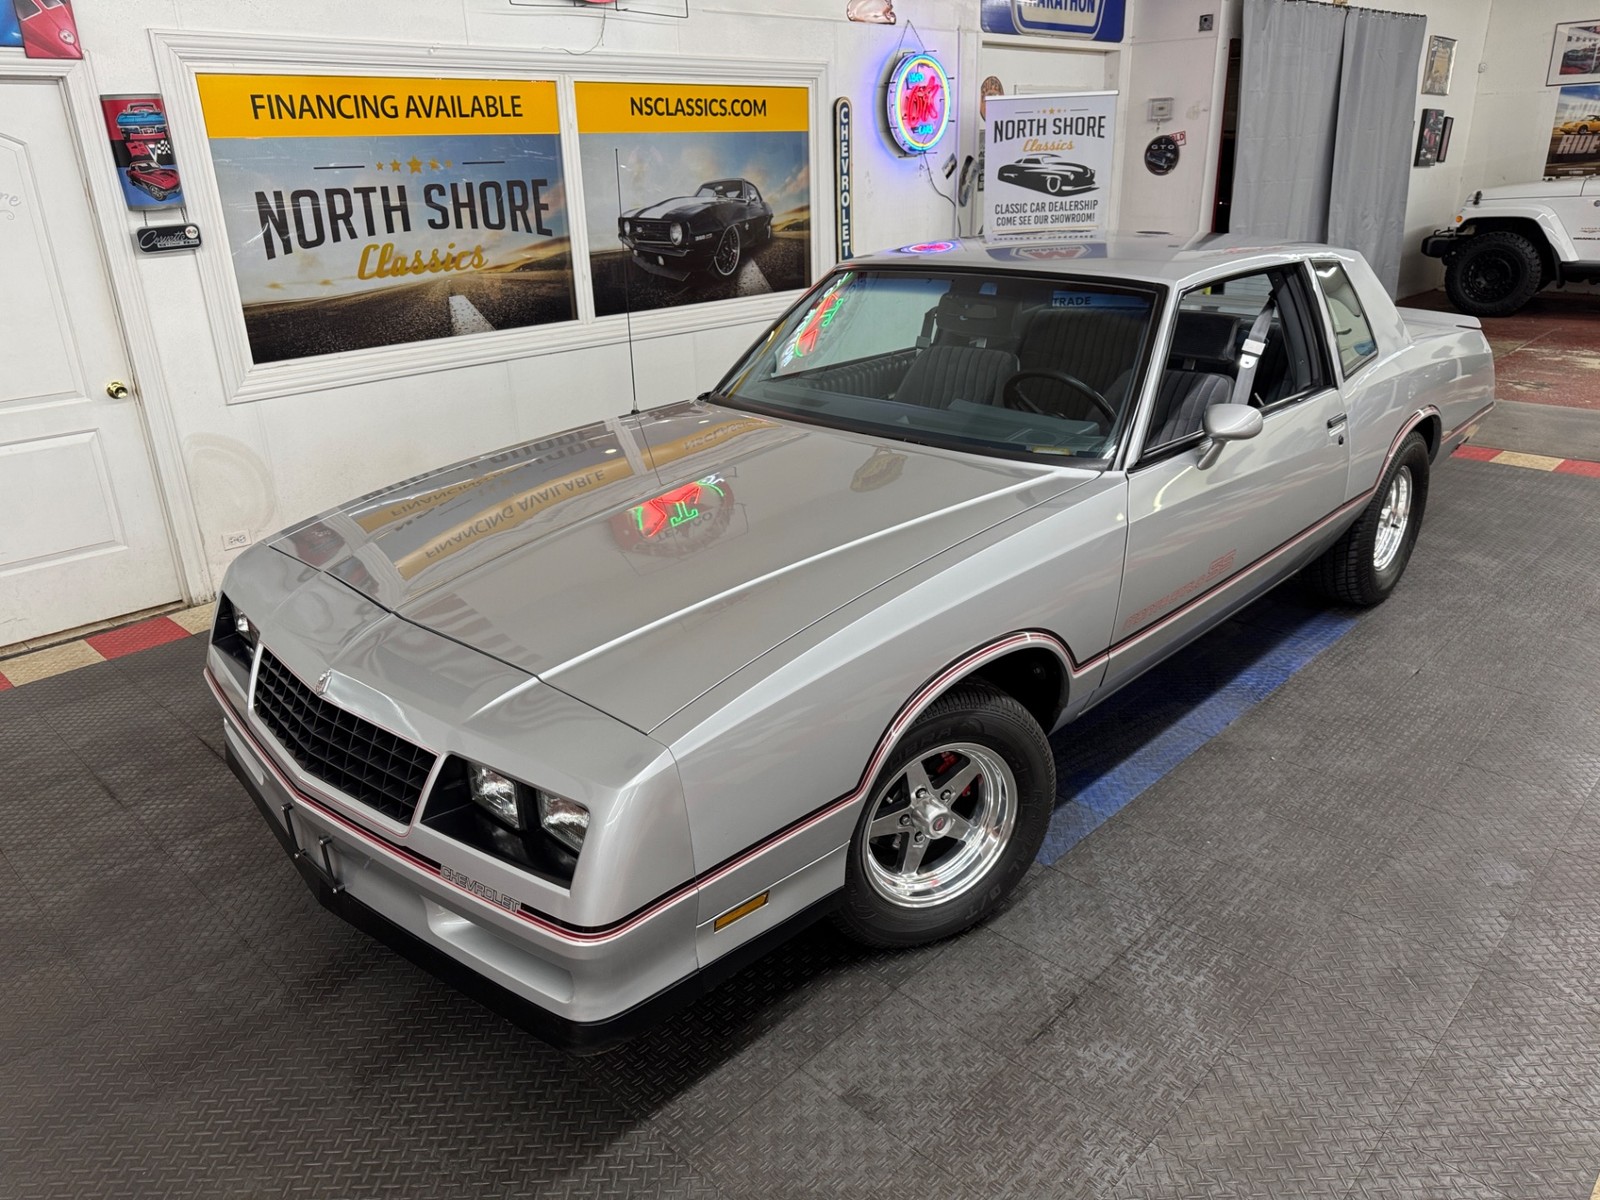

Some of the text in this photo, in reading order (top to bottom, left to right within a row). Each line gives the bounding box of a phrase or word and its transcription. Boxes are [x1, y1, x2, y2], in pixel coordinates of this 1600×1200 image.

[250, 94, 523, 120] FINANCING AVAILABLE
[630, 97, 767, 117] NSCLASSICS.COM
[993, 115, 1106, 143] NORTH SHORE
[1022, 139, 1074, 152] Classics
[1556, 134, 1599, 155] RIDE
[840, 107, 850, 257] CHEVROLET
[994, 199, 1099, 215] CLASSIC CAR DEALERSHIP
[254, 178, 553, 260] NORTH SHORE
[996, 212, 1096, 227] COME SEE OUR SHOWROOM!
[139, 230, 188, 249] Corvette
[357, 242, 488, 280] Classics
[1053, 296, 1092, 306] TRADE
[441, 865, 520, 913] CHEVROLET
